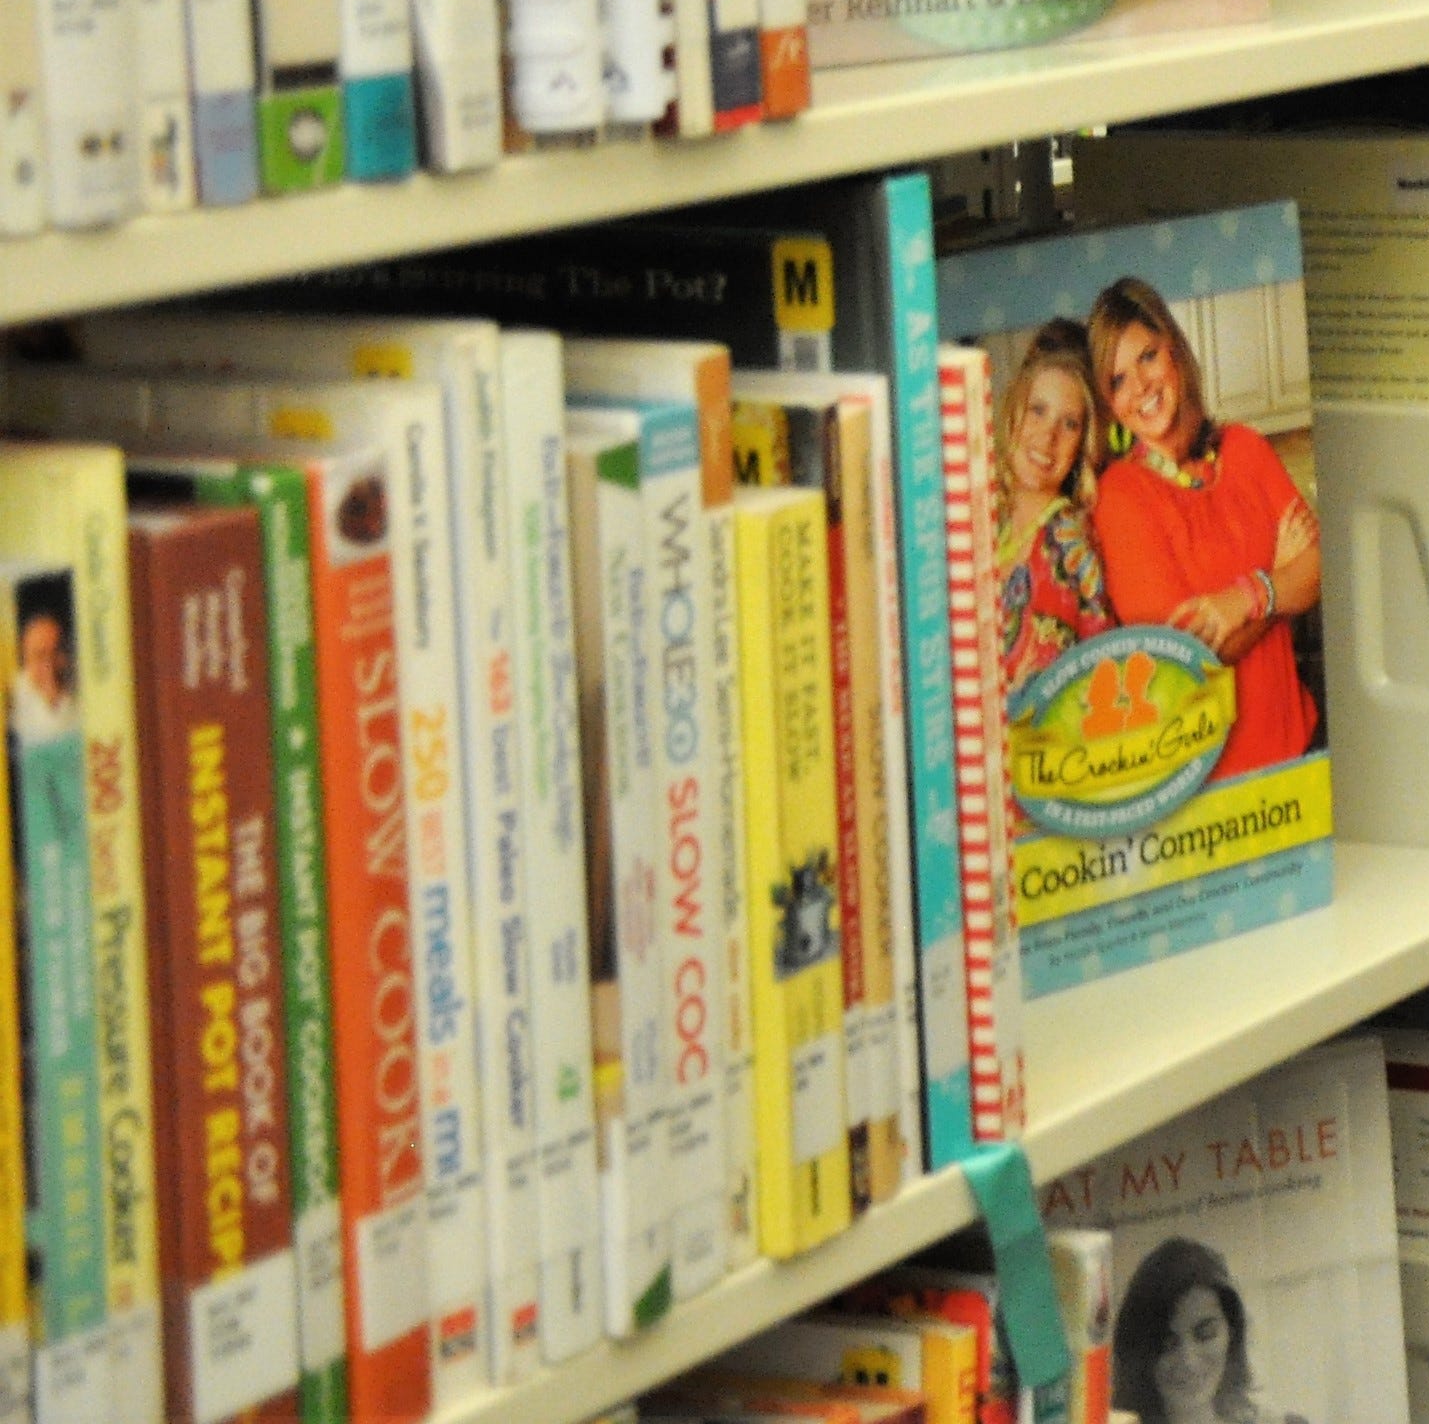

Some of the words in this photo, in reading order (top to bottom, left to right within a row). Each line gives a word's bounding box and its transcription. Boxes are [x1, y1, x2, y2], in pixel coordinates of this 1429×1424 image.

[645, 267, 729, 303] Pot?
[783, 259, 820, 307] M
[349, 645, 409, 880] SLOW
[410, 703, 445, 804] 250
[1017, 751, 1055, 787] The
[1155, 710, 1218, 758] Girls
[187, 726, 240, 969] INSTANT
[235, 818, 268, 886] THE
[496, 809, 523, 905] Paleo
[666, 778, 704, 938] SLOW
[1020, 837, 1134, 901] Cookin'
[1139, 796, 1303, 868] Companion
[242, 902, 270, 984] BIG
[422, 884, 465, 1047] meals
[500, 914, 525, 998] Slow
[101, 905, 139, 1093] Pressure
[200, 983, 244, 1091] POT
[243, 999, 277, 1109] BOOK
[505, 1009, 530, 1128] Cooker
[106, 1107, 141, 1268] Cooker
[206, 1112, 250, 1294] RECIP
[250, 1141, 280, 1203] OF
[1040, 1165, 1098, 1218] AT
[1118, 1150, 1187, 1200] MY
[1205, 1116, 1339, 1182] TABLE
